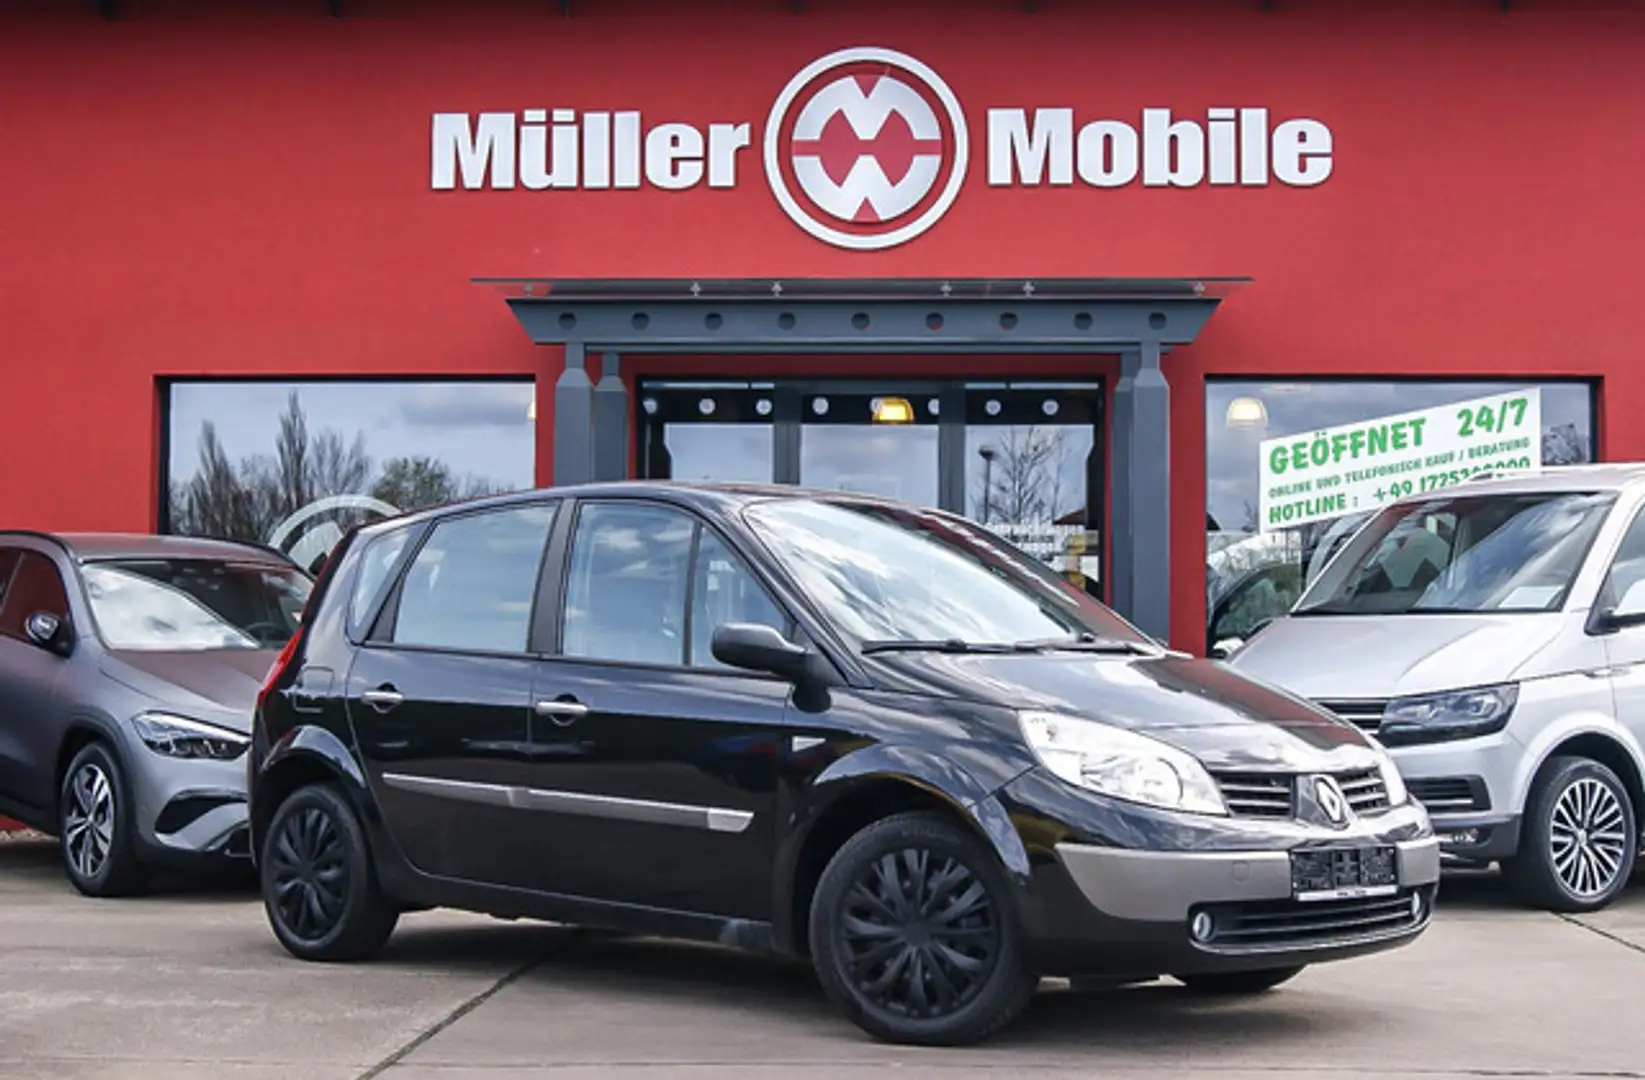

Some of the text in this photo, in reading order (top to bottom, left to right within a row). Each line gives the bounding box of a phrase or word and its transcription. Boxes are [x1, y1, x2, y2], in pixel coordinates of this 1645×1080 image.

[431, 107, 1334, 190] Müller Mobile
[1268, 480, 1312, 498] ONLINE
[1316, 474, 1342, 490] UND
[1424, 450, 1455, 467] KAUF
[1468, 437, 1530, 459] BERATUNG
[1269, 397, 1529, 474] GEÖFFNET 24/7
[1268, 492, 1346, 524] HOTLINE
[1373, 480, 1413, 501] +49
